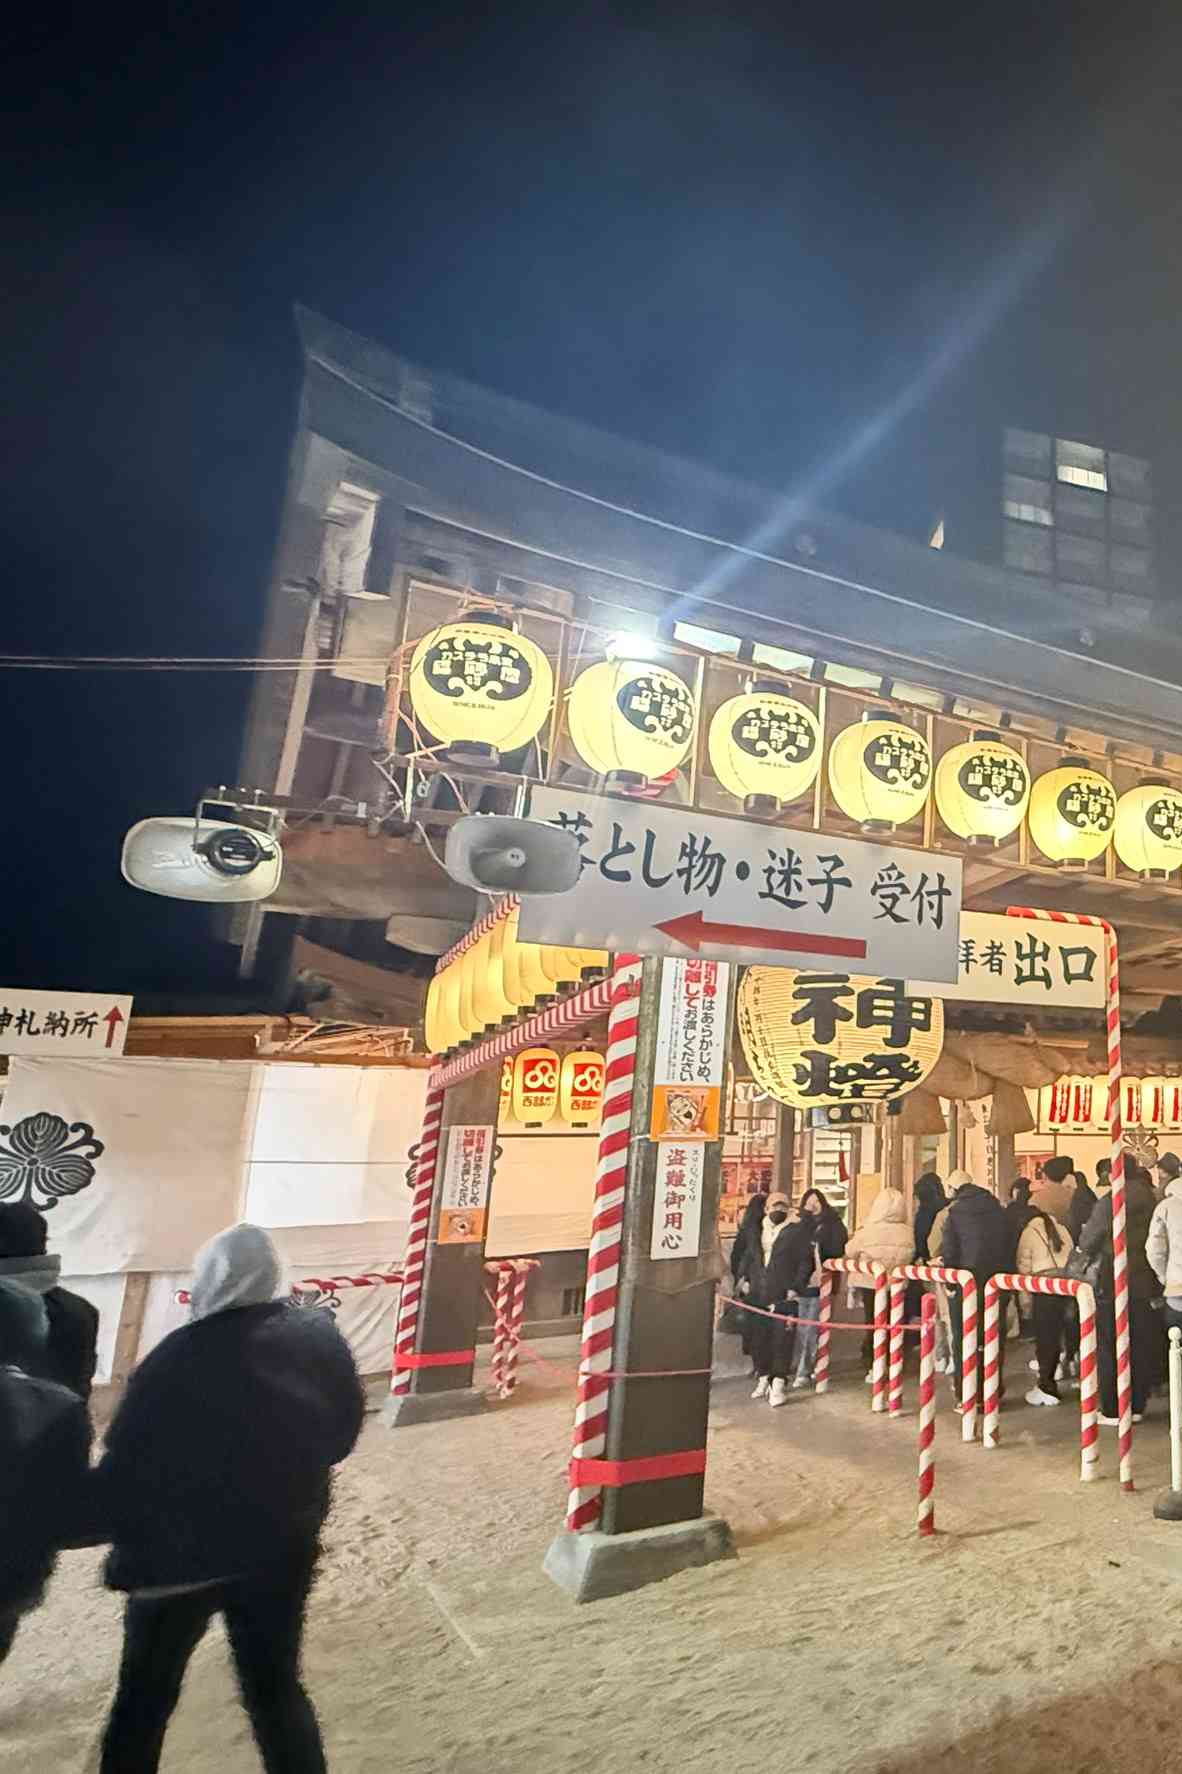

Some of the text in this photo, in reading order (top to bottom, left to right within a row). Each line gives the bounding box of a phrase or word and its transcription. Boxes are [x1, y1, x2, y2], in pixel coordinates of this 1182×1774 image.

[870, 861, 953, 931] 受付
[660, 1148, 688, 1251] 盗難御用心
